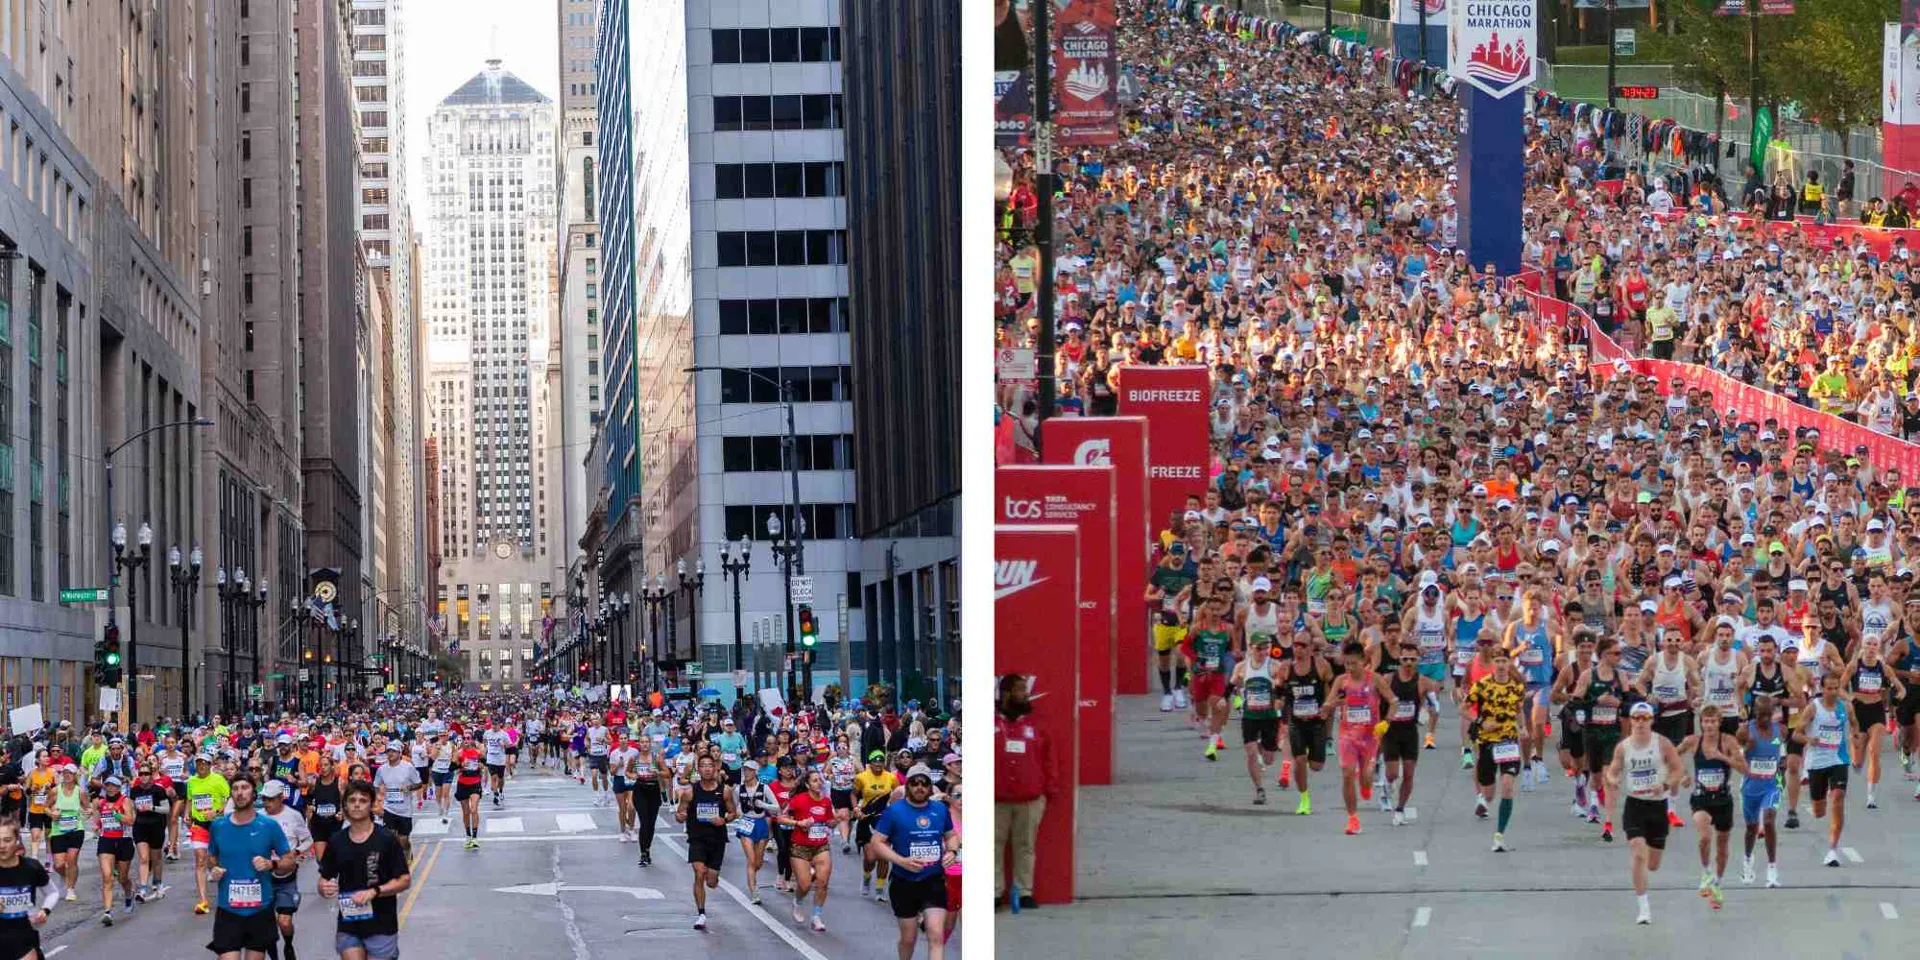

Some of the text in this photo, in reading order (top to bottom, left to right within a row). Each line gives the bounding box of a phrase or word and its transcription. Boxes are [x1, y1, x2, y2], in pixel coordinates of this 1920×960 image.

[1467, 4, 1531, 17] CHICAGO
[1467, 18, 1531, 28] MARATHON
[1063, 40, 1108, 50] CHICAGO
[1116, 75, 1132, 93] A
[1151, 467, 1201, 478] FREEZE
[1006, 496, 1042, 518] tcs
